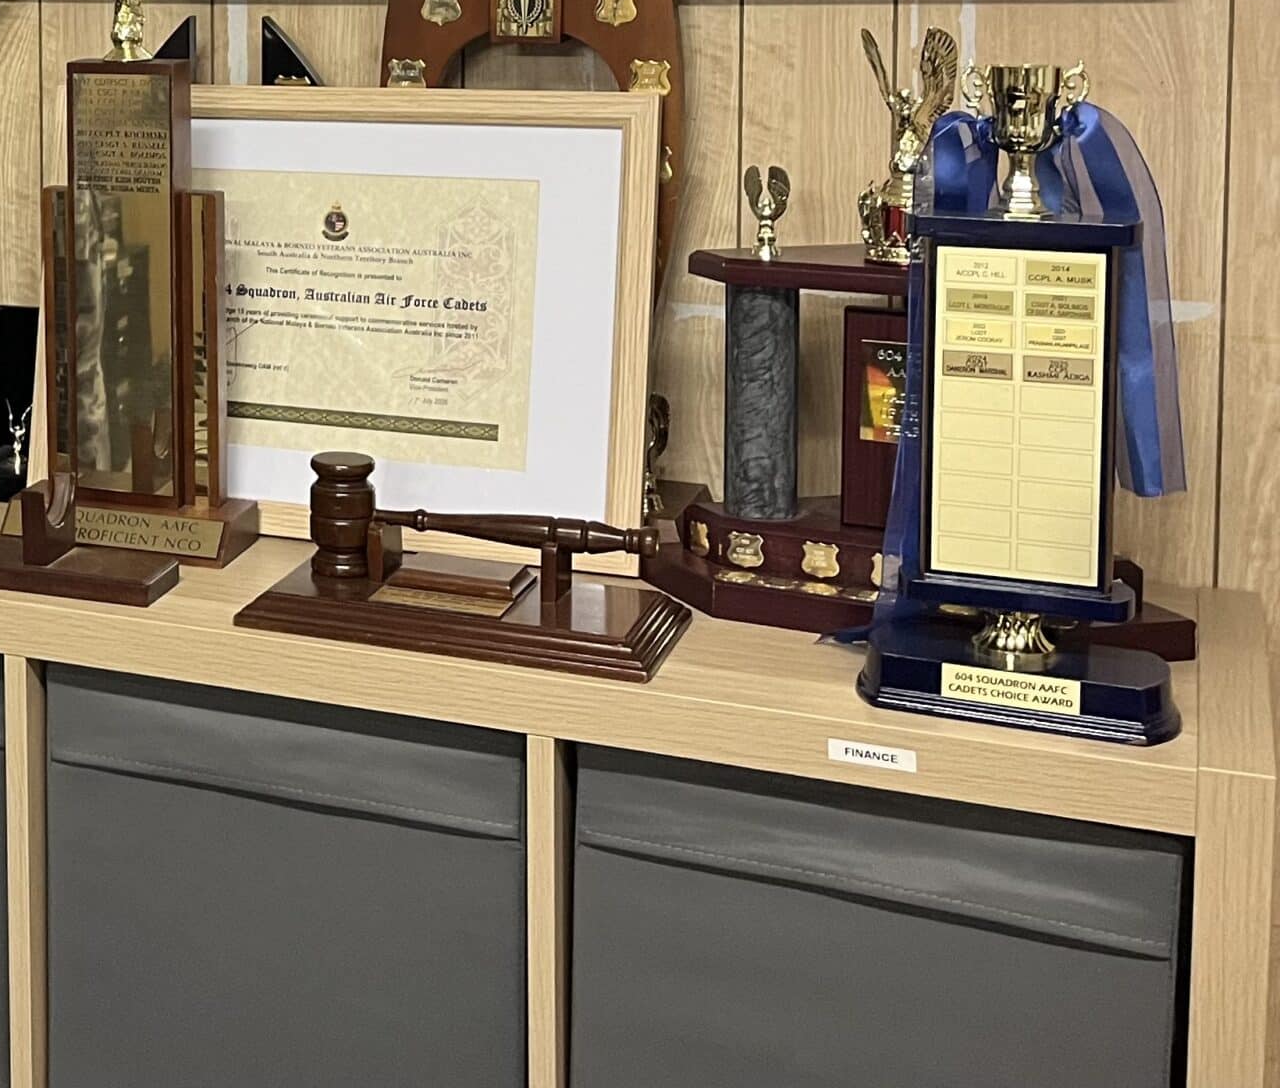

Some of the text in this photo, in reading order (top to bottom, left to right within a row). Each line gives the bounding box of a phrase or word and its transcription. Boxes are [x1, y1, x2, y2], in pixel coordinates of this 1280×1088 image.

[279, 250, 311, 259] Australia
[357, 245, 411, 256] ASSOCIATION
[236, 283, 488, 312] Squadron, Australian Air Force Cadets
[876, 349, 903, 362] 604
[75, 508, 200, 535] QUADRON AAFC
[163, 538, 202, 552] NCO
[954, 671, 1068, 695] 604 SQUADRON AAFC
[948, 682, 1074, 708] CADETS CHOICE AWARD
[844, 747, 899, 764] FINANCE
